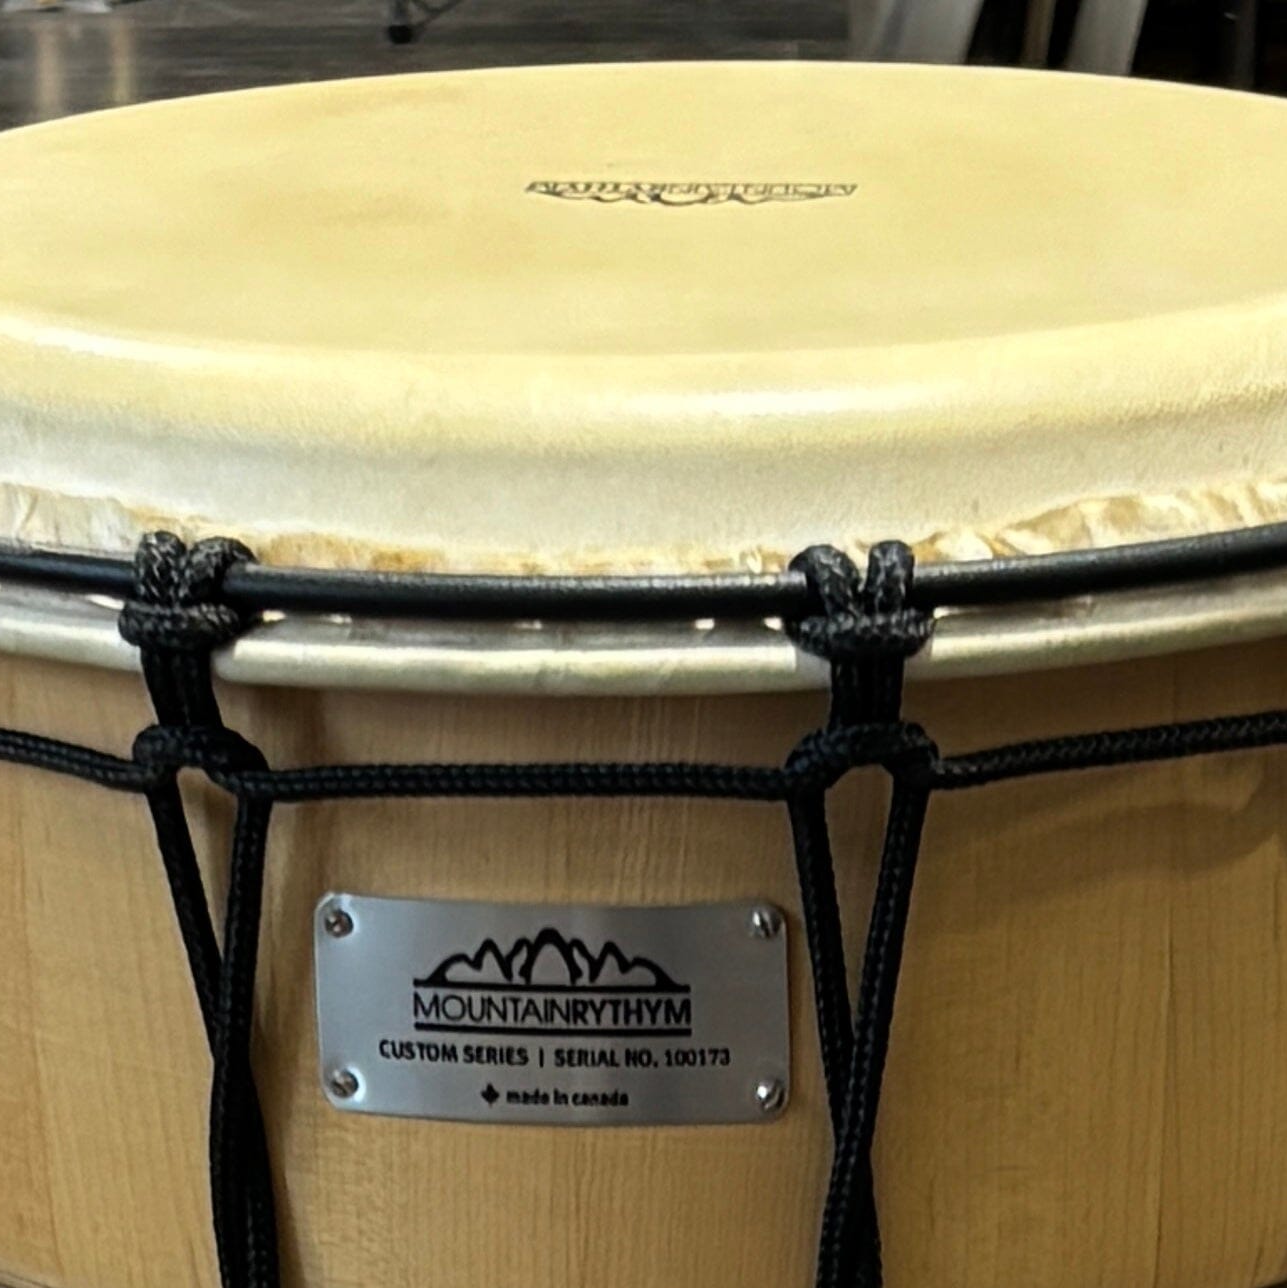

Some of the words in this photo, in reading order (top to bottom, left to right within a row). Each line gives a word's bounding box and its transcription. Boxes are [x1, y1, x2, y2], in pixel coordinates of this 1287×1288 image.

[412, 991, 692, 1026] MOUNTAINRYTHYM
[379, 1039, 458, 1063] CUSTOM
[463, 1044, 529, 1066] SERIES
[554, 1047, 620, 1067] SERIAL
[625, 1047, 658, 1068] NO.
[664, 1047, 731, 1067] 100173
[506, 1088, 549, 1105] made
[553, 1087, 568, 1105] in
[572, 1089, 630, 1106] canada
